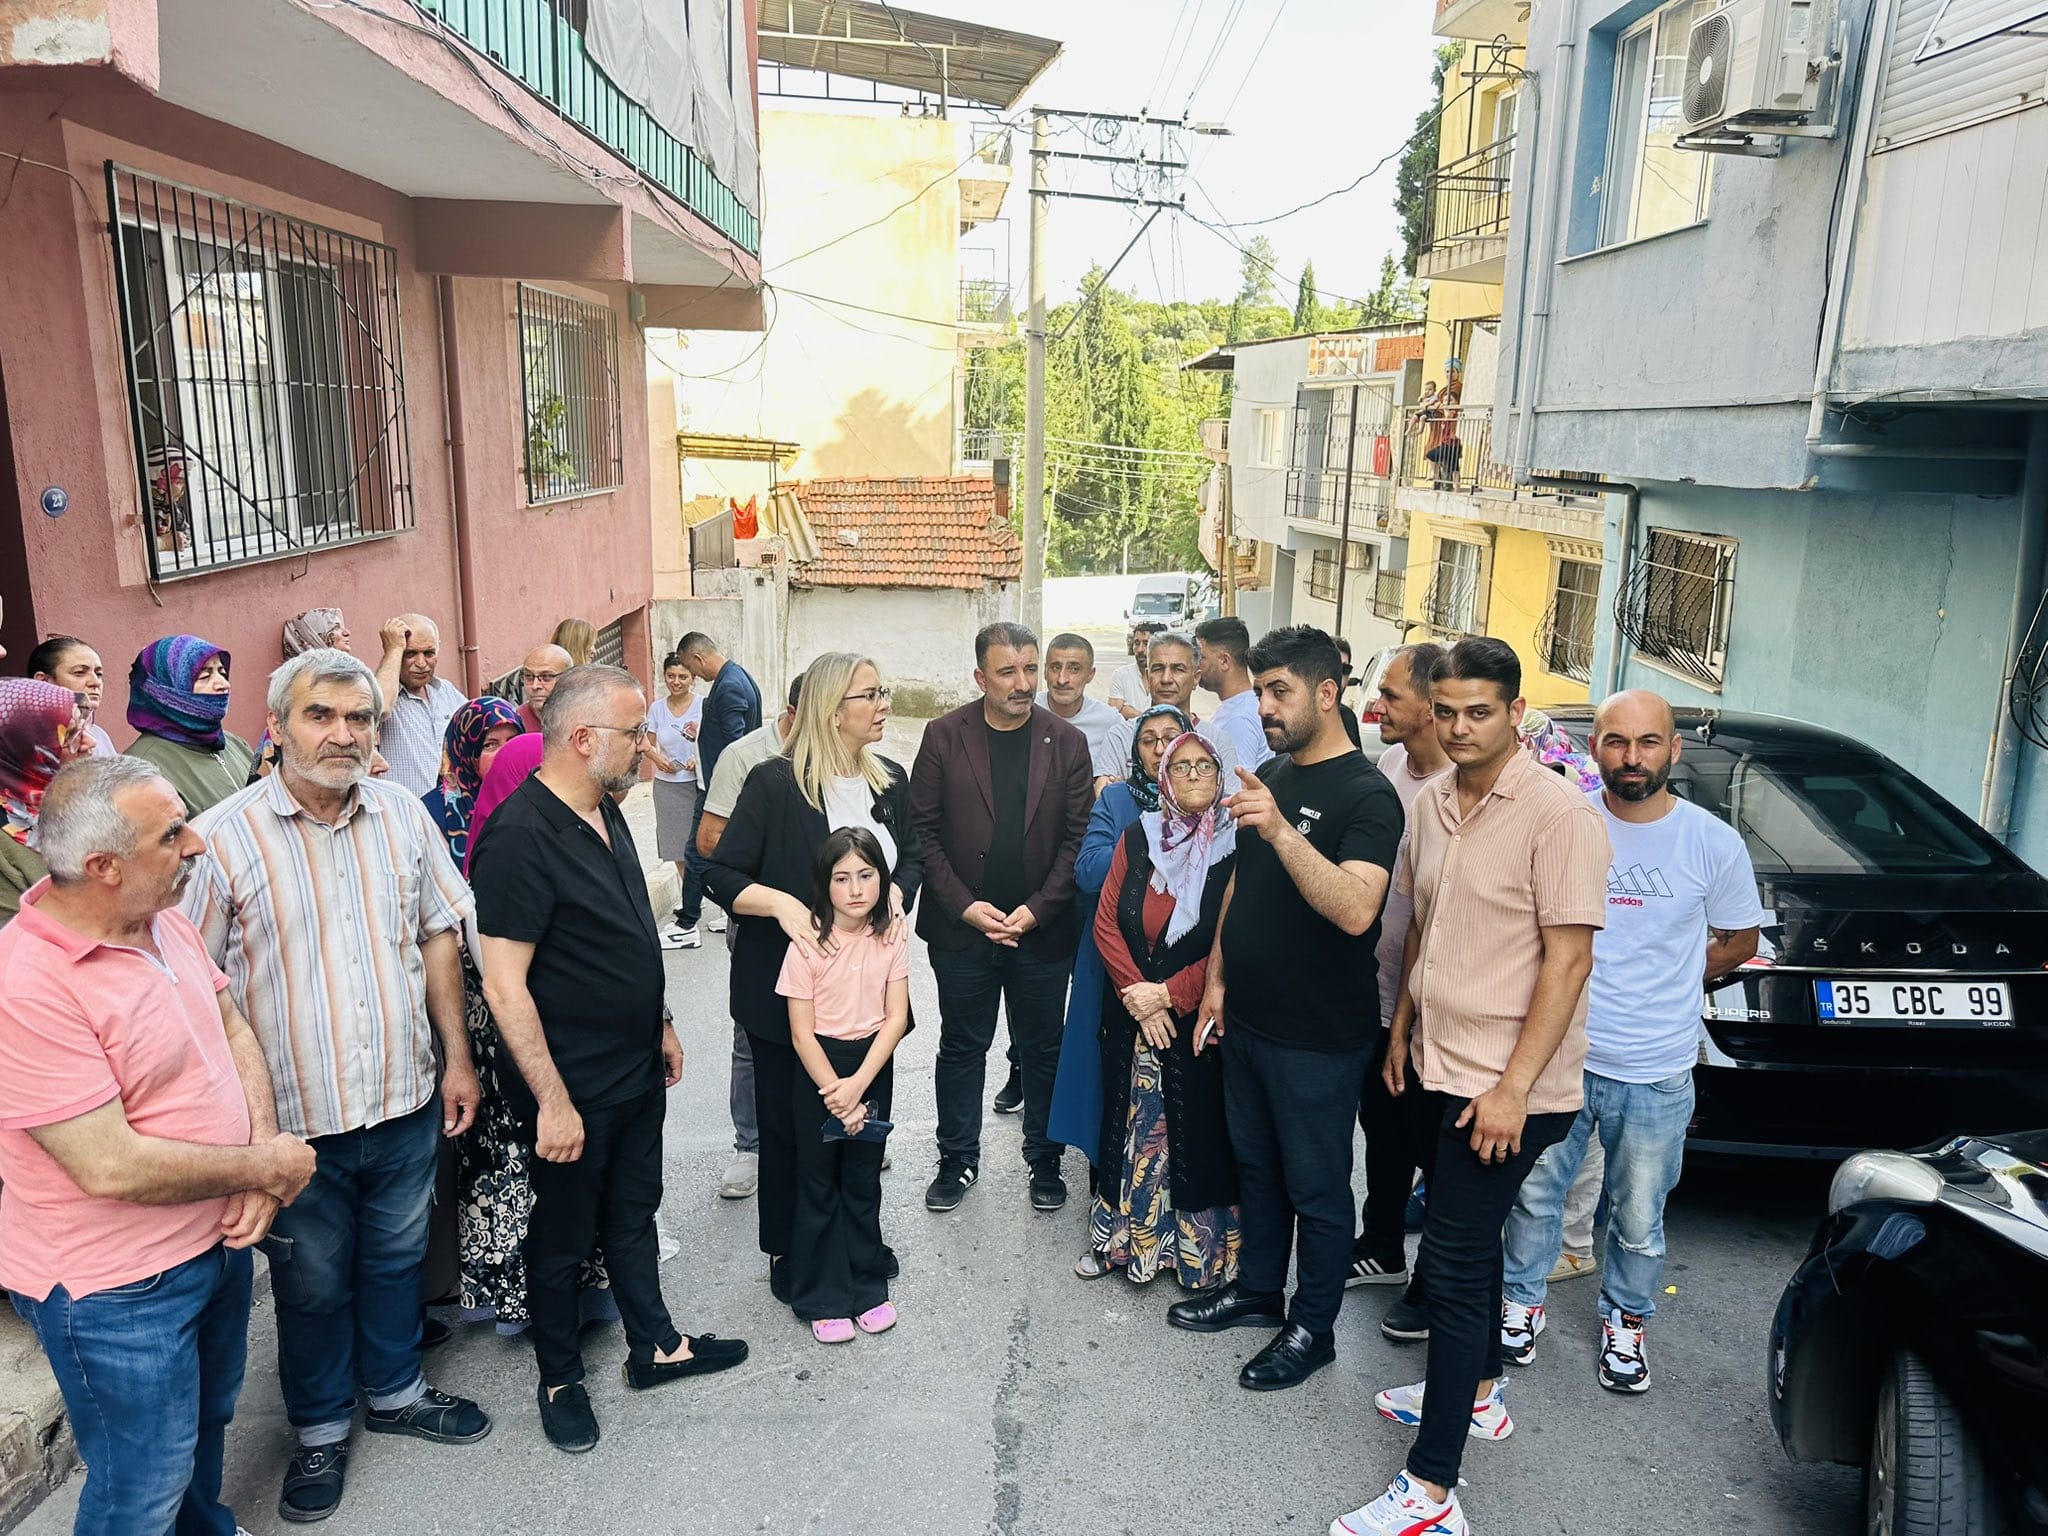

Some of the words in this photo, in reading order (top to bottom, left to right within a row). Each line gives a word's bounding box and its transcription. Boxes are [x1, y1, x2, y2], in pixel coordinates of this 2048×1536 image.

[1608, 896, 1643, 907] adidas
[1813, 937, 2010, 955] ŠKODA
[1820, 1002, 1833, 1012] TR
[1835, 985, 1871, 1015] 35
[1892, 986, 1945, 1016] CBC
[1967, 986, 2004, 1016] 99
[1706, 1007, 1771, 1019] SUPERB
